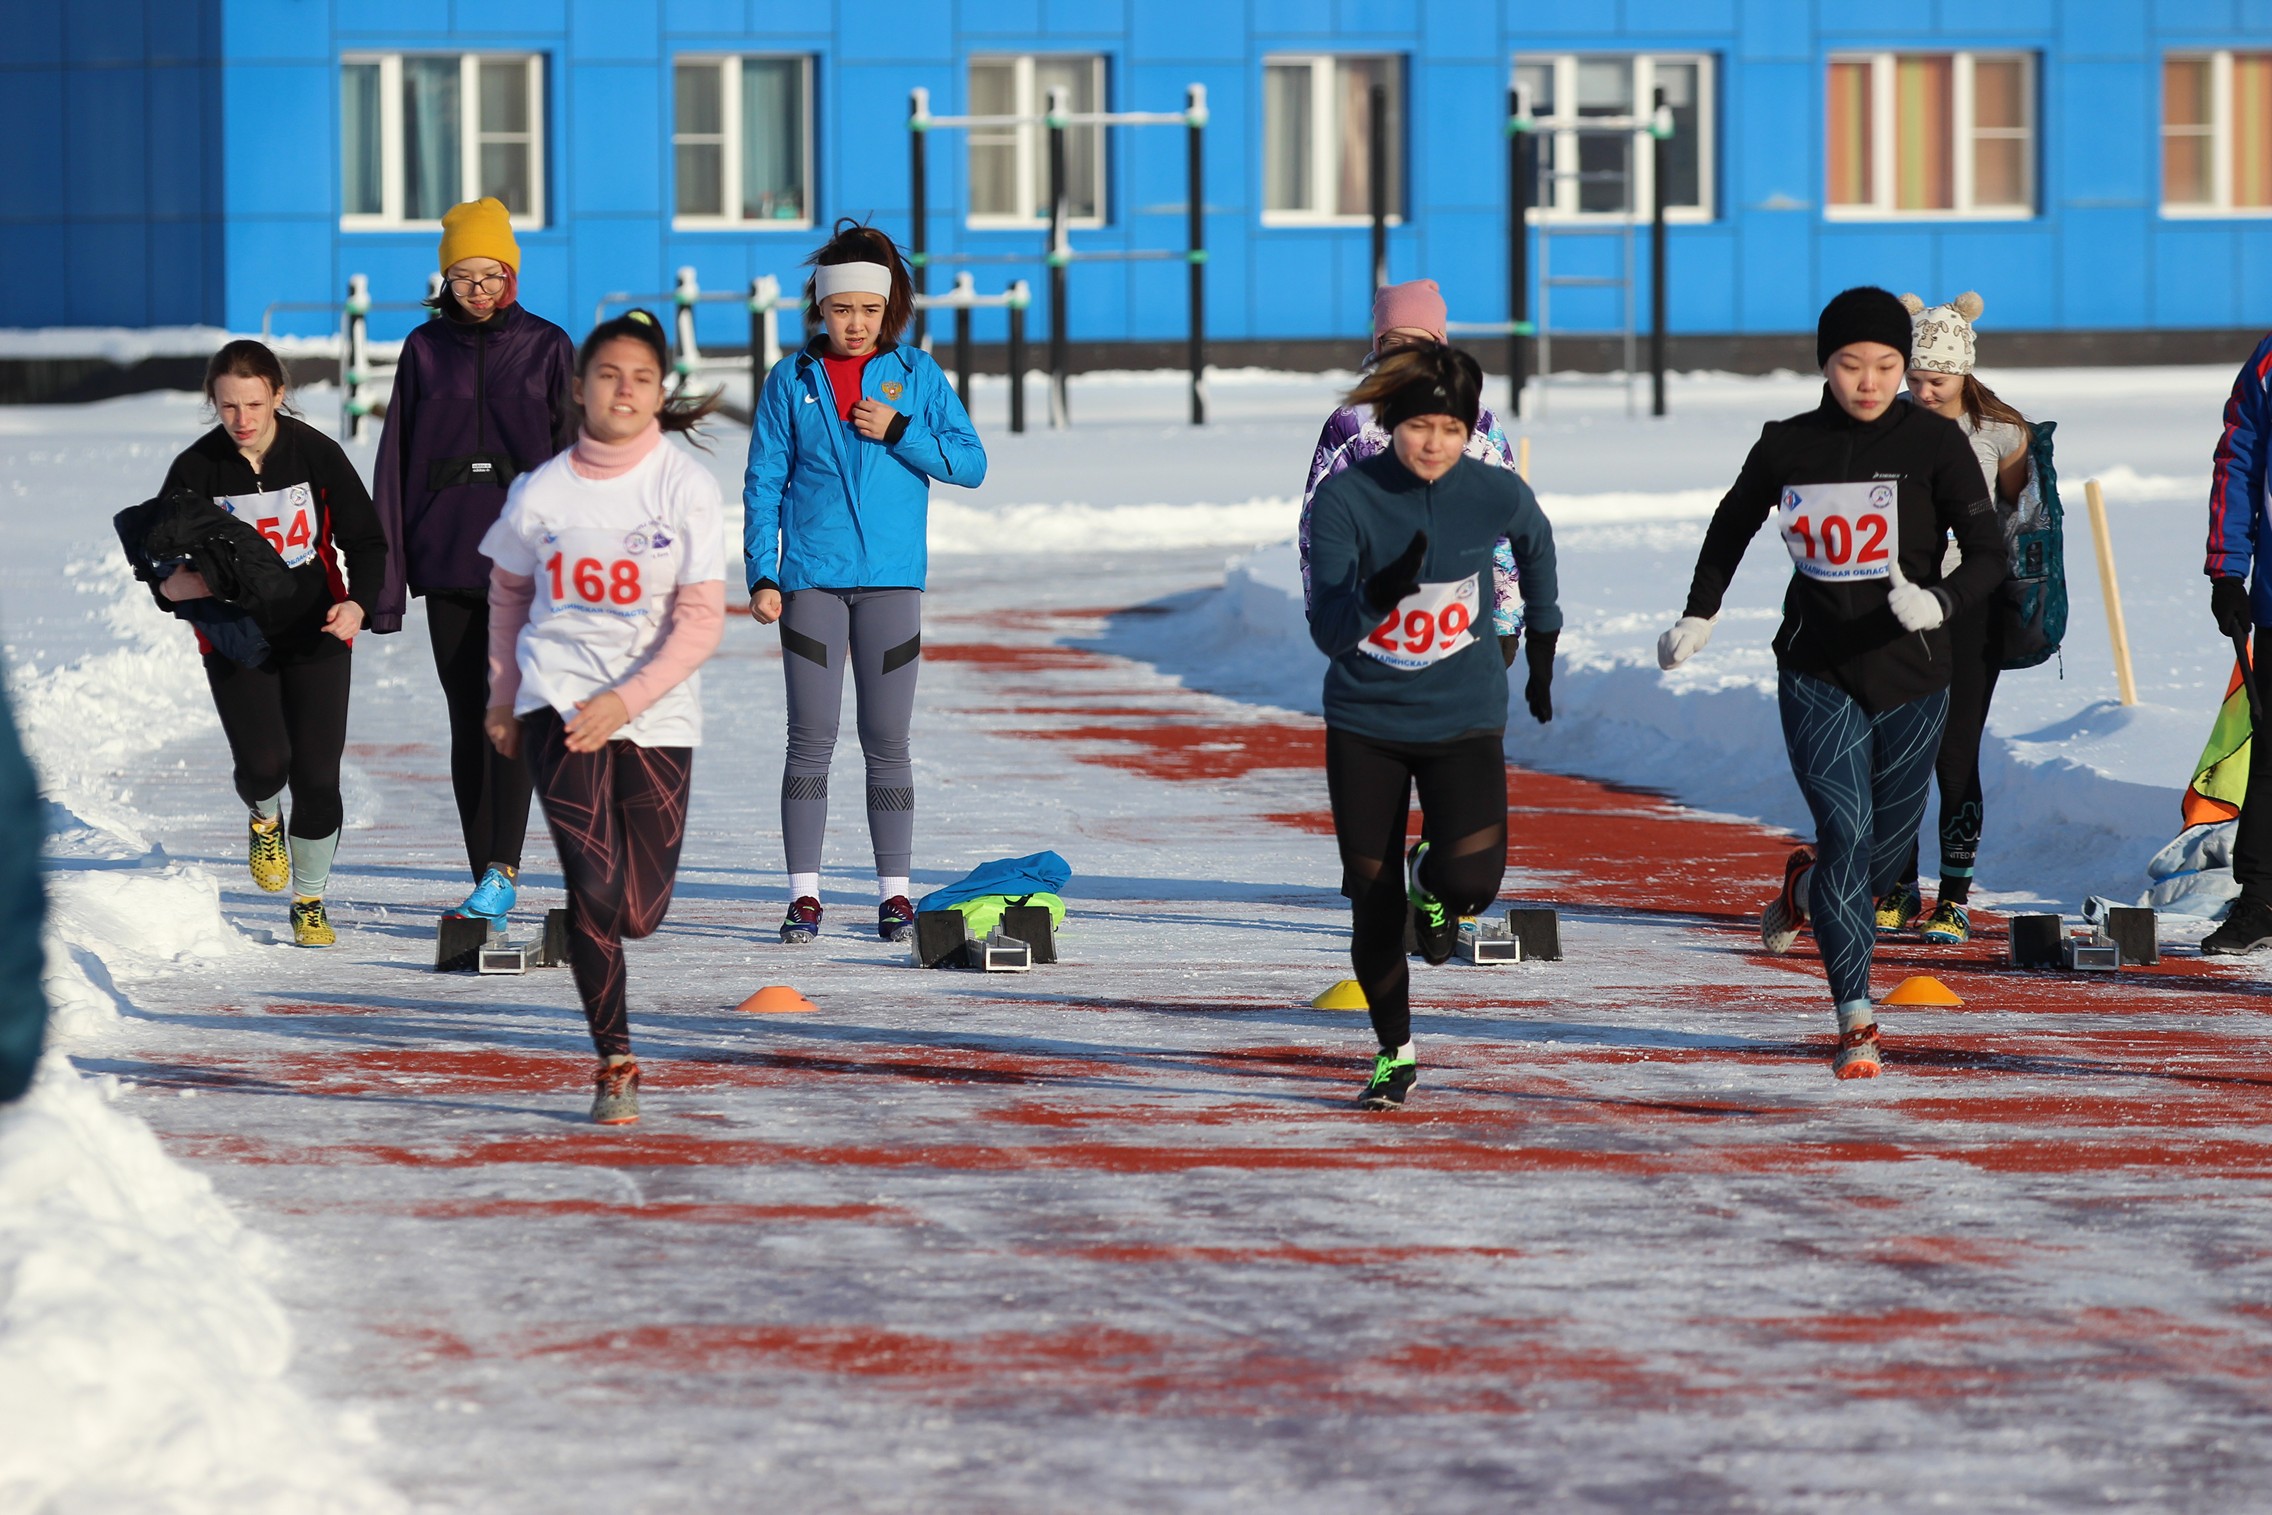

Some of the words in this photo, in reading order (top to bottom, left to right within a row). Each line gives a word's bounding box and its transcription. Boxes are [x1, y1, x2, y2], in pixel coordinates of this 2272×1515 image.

[256, 509, 311, 555] 54
[1789, 513, 1889, 565] 102
[545, 551, 642, 605] 168
[1853, 565, 1889, 576] ОБЛАСТ
[1368, 602, 1470, 654] 299
[1367, 651, 1428, 667] АХАЛИНСКАЯ
